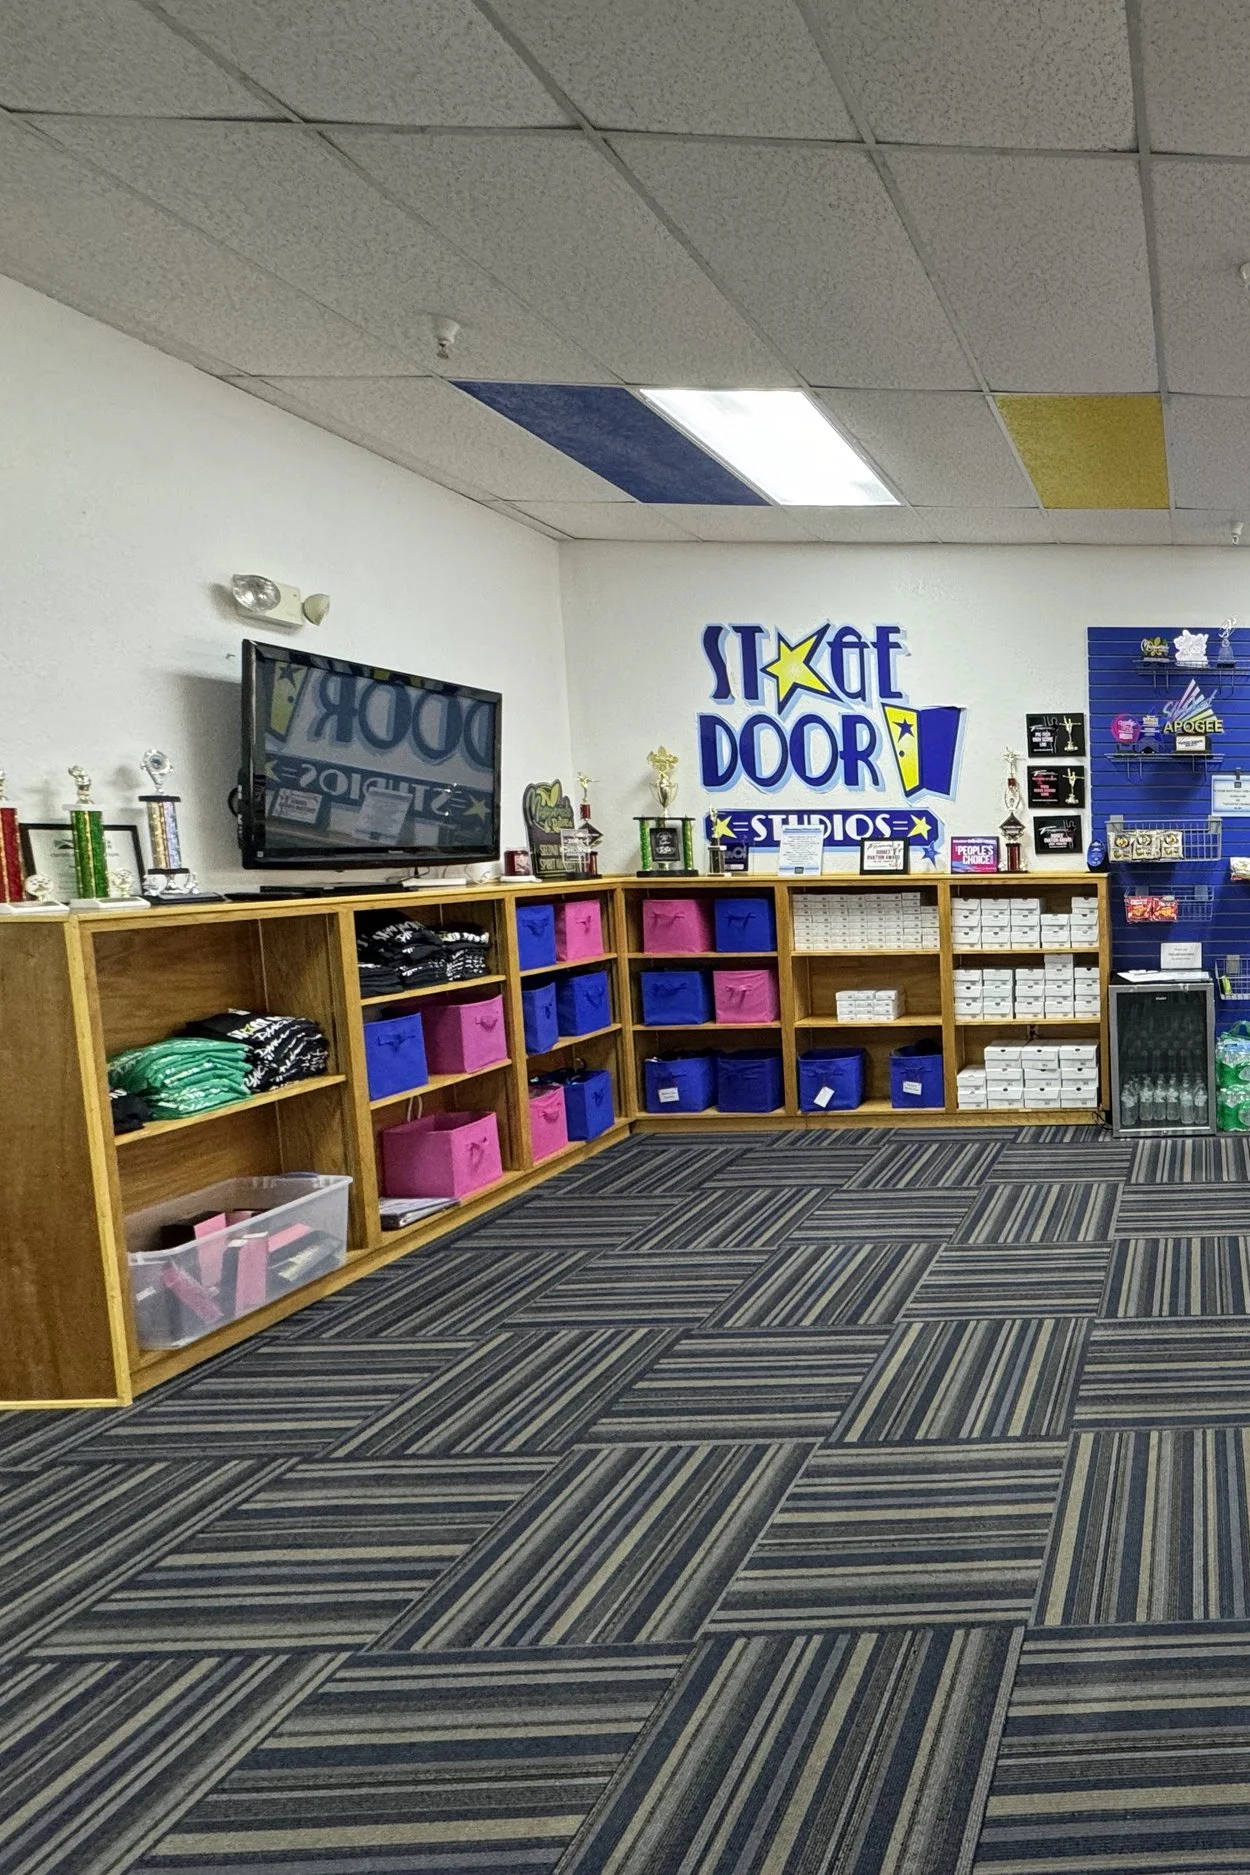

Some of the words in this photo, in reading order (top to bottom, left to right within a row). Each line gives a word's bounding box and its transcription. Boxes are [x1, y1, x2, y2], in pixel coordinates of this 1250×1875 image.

[1163, 720, 1223, 734] APOGEE
[700, 714, 880, 787] DOOR
[958, 846, 994, 855] PEOPLE'S
[963, 855, 990, 865] CHOICE
